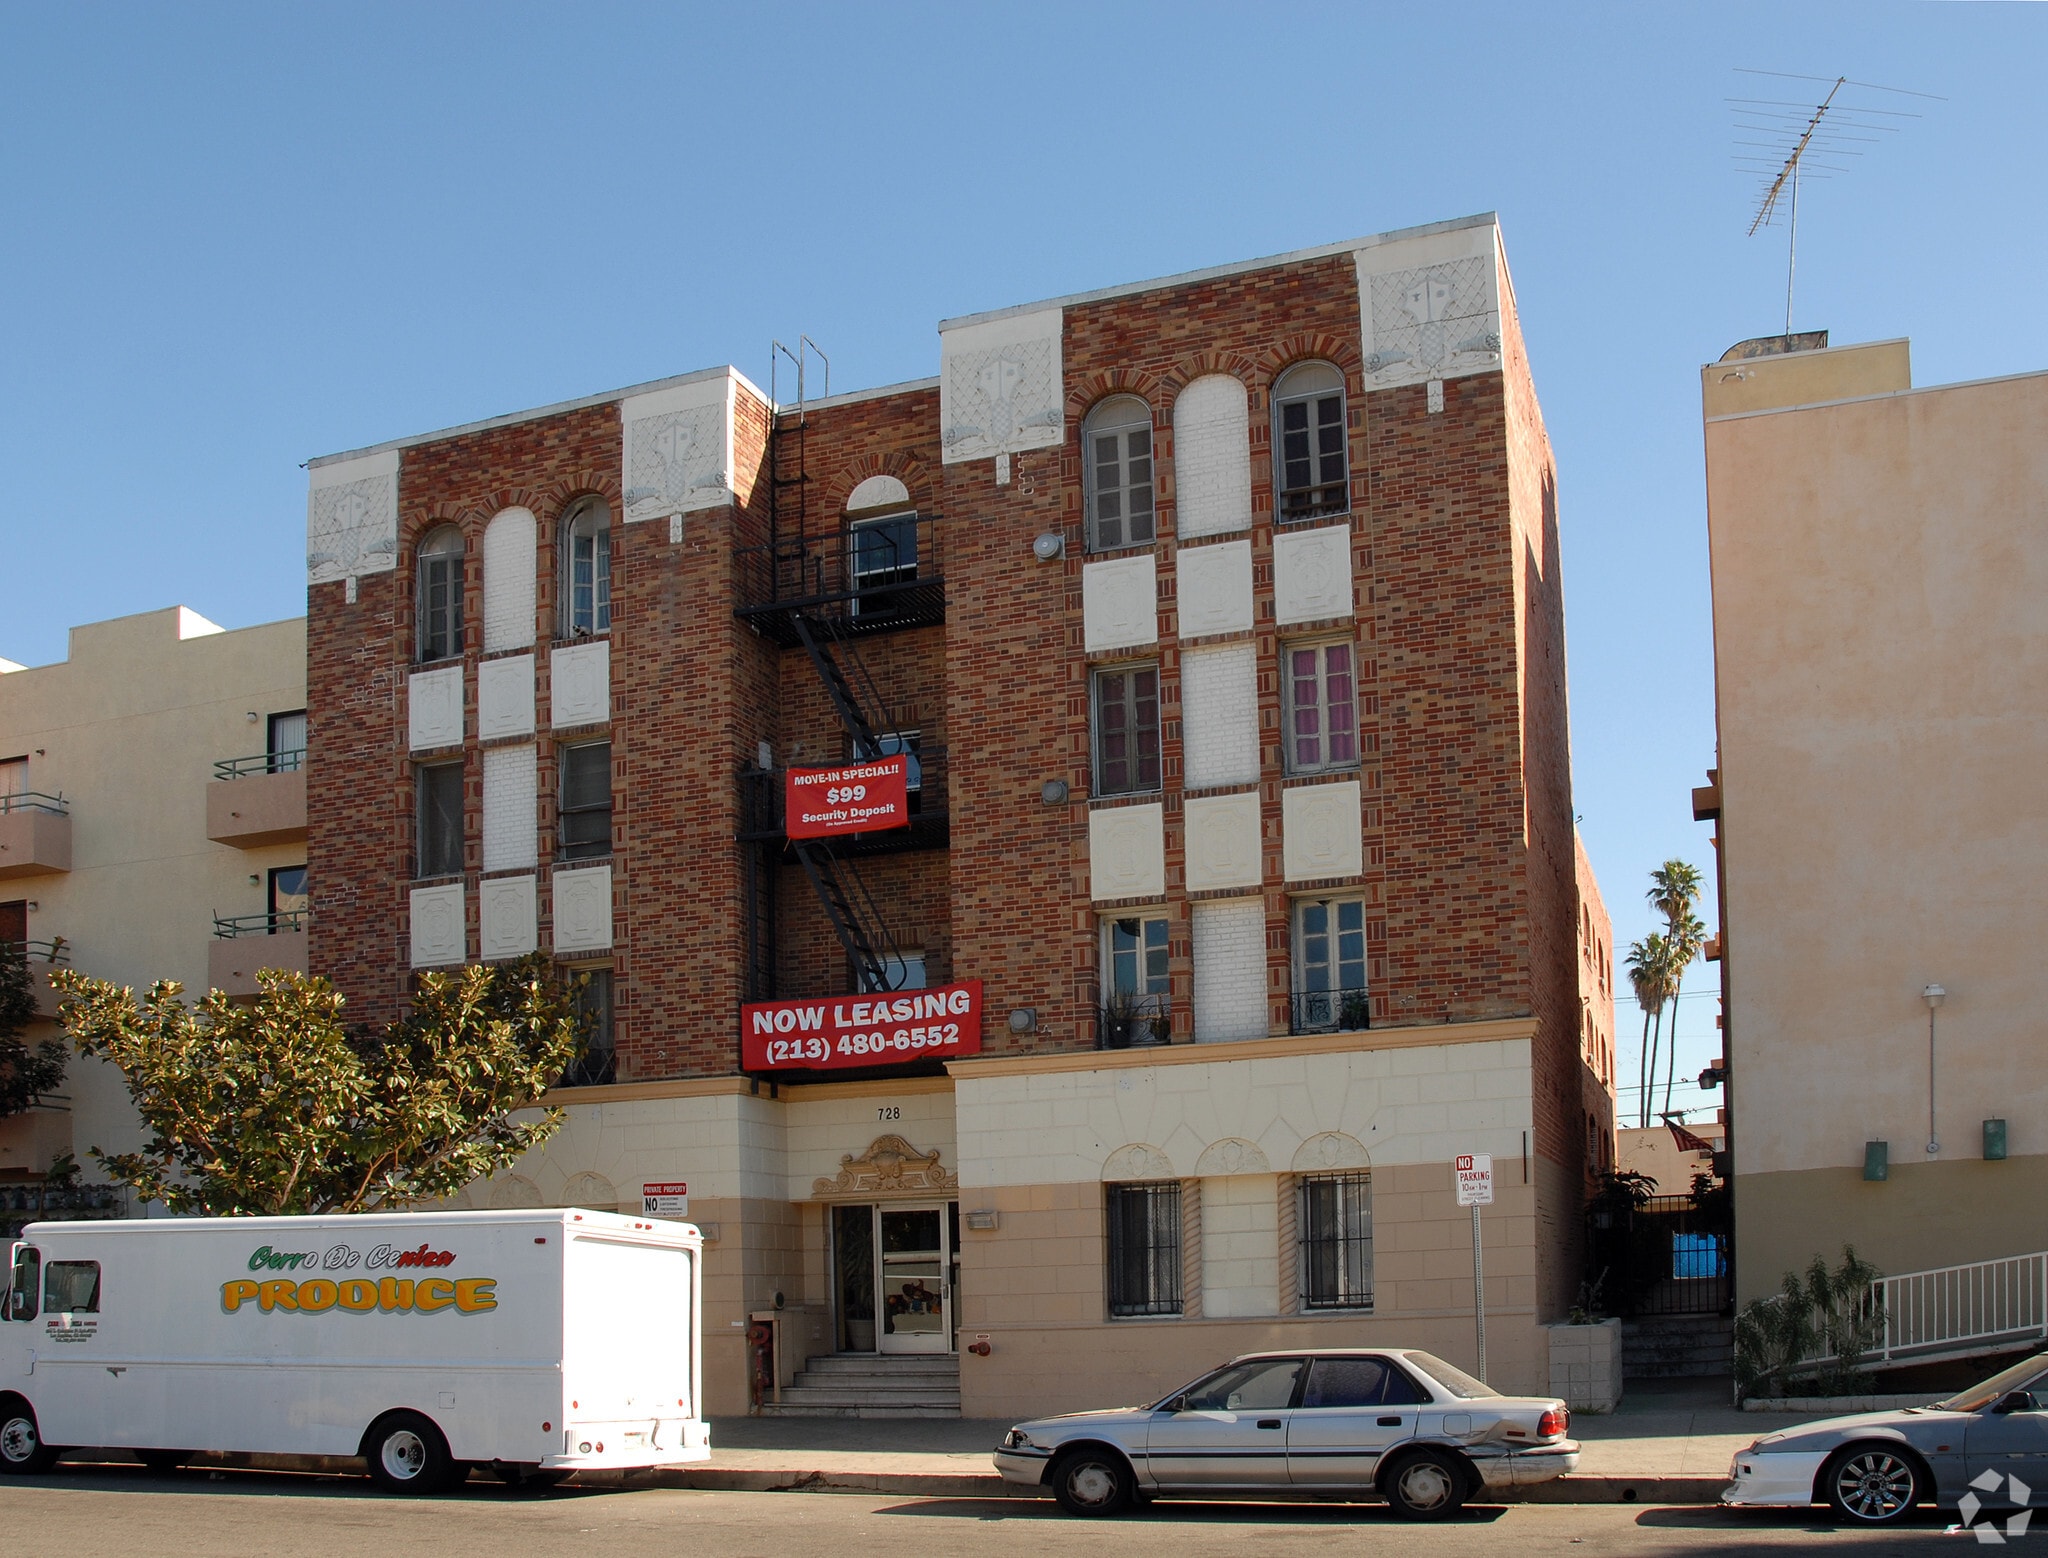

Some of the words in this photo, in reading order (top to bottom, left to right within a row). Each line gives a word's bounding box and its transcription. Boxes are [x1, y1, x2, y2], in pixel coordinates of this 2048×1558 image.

[794, 771, 840, 786] MOVE-IN
[842, 764, 899, 781] SPECIAL!!
[827, 784, 866, 805] $99
[802, 809, 847, 823] Security
[850, 803, 895, 818] Deposit
[753, 1006, 825, 1035] NOW
[834, 990, 970, 1028] LEASING
[766, 1038, 830, 1064] (213)
[837, 1023, 959, 1056] 480-6552
[878, 1107, 900, 1120] 728
[1458, 1157, 1471, 1169] NO
[1460, 1171, 1490, 1182] PARKING
[663, 1185, 686, 1193] PROPERTY
[645, 1197, 658, 1212] NO
[248, 1245, 319, 1271] Cerro
[323, 1244, 361, 1270] De
[366, 1243, 457, 1270] Ceniza
[222, 1276, 498, 1313] PRODUCE
